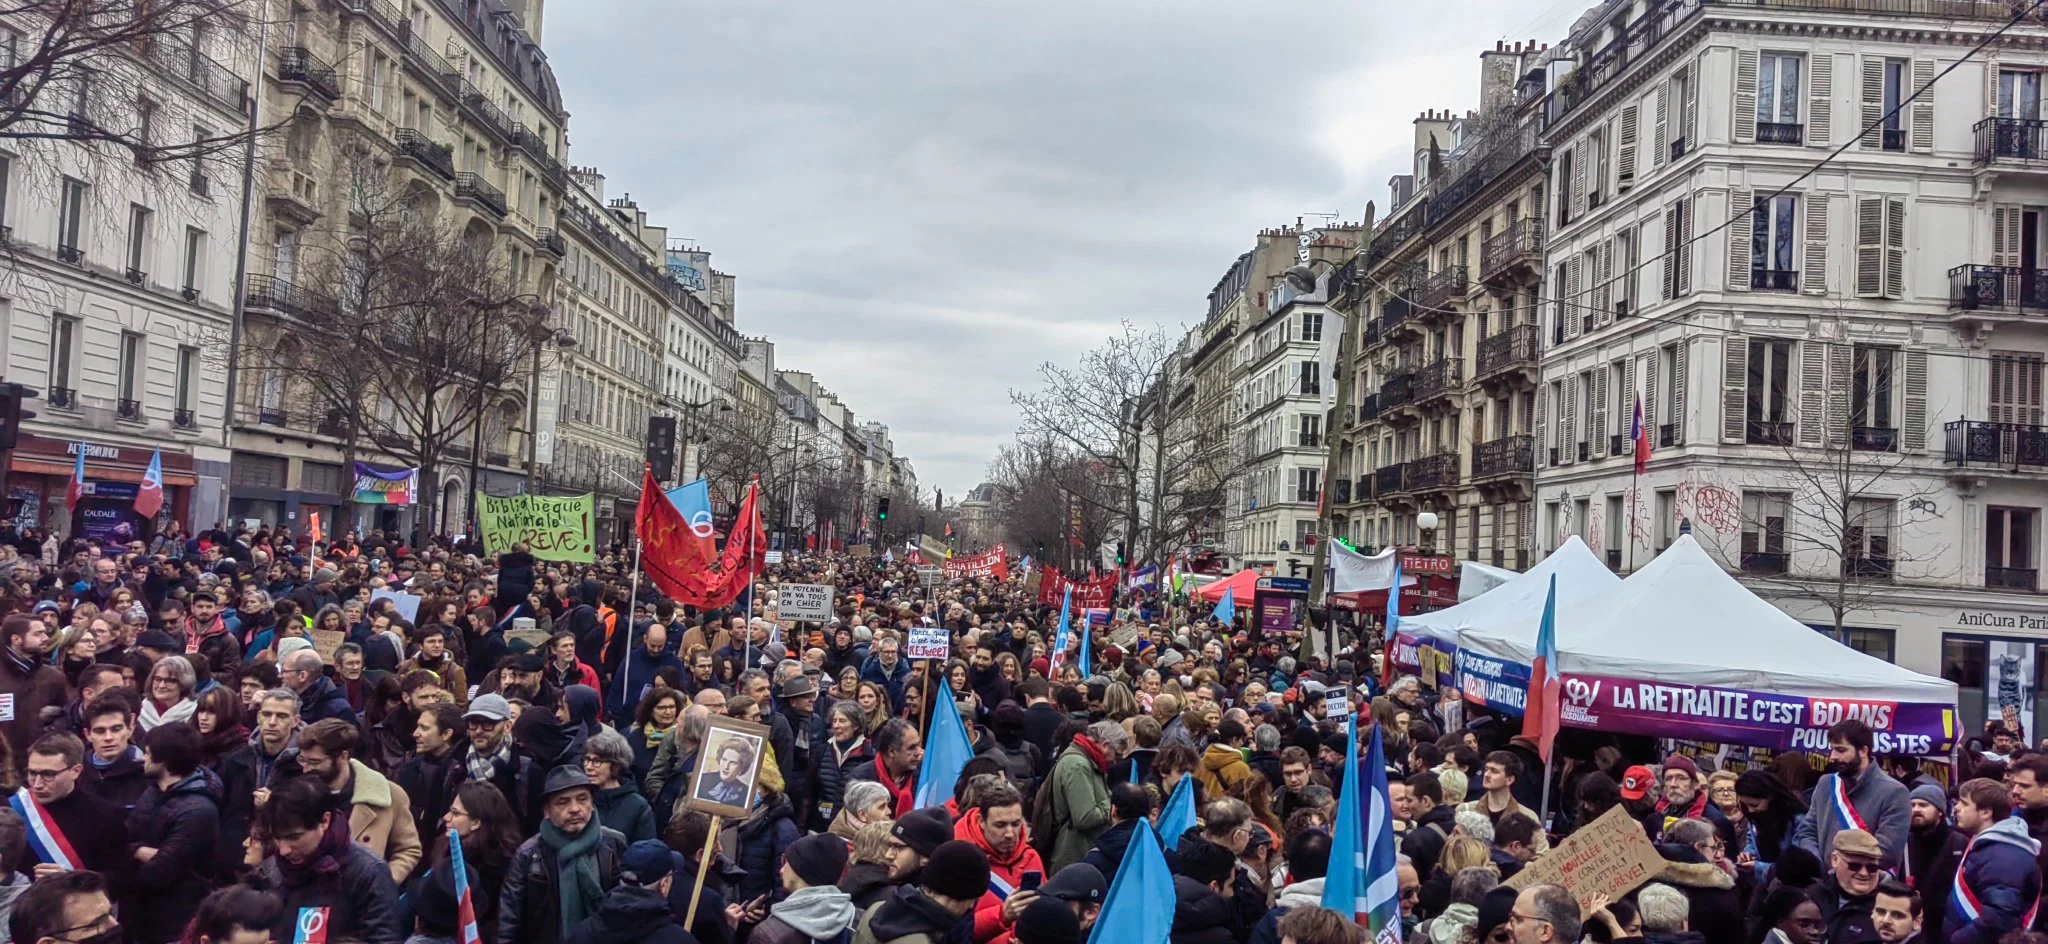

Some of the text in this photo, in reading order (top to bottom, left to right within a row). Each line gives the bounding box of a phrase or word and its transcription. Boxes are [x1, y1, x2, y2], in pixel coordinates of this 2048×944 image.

[1957, 611, 2048, 630] AniCura Pari
[1613, 686, 1636, 709] LA
[1639, 683, 1749, 721] RETRAITE
[1752, 699, 1804, 725] C'EST
[1812, 701, 1843, 727] 60
[1846, 703, 1893, 730] ANS
[1560, 711, 1599, 724] INSOUMISE
[1791, 727, 1831, 750] POU
